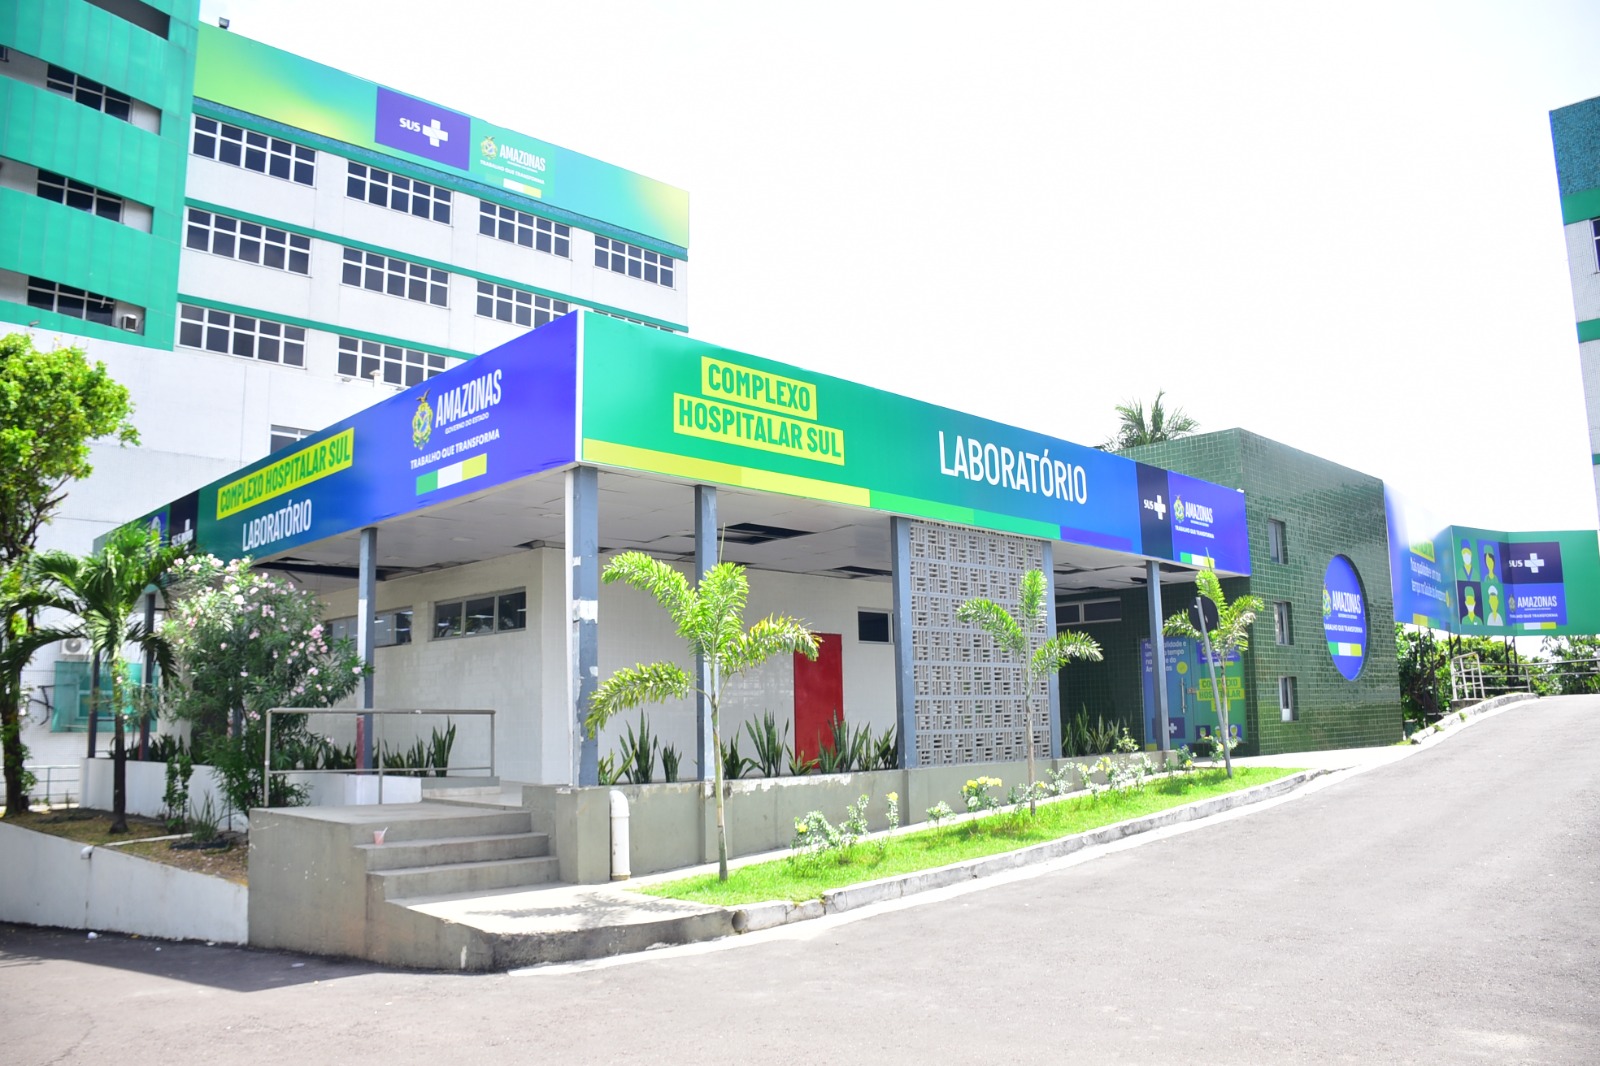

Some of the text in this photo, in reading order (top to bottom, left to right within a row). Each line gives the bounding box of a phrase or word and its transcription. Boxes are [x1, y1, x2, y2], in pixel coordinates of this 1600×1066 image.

[399, 117, 421, 132] SUS
[499, 144, 546, 172] AMAZONAS
[435, 369, 502, 428] AMAZONAS
[708, 363, 811, 412] COMPLEXO
[444, 421, 465, 435] GOVERNO
[472, 412, 490, 425] ESTADO
[679, 398, 842, 458] HOSPITALAR SUL
[410, 428, 500, 470] TRABALHO QUE TRANSFORMA
[220, 435, 351, 513] COMPLEXO HOSPITALAR SUL
[938, 430, 1088, 505] LABORATÓRIO
[1143, 499, 1154, 510] SUS
[1185, 501, 1214, 524] AMAZONAS
[242, 498, 312, 552] LABORATÓRIO
[1508, 559, 1523, 568] SUS
[1332, 590, 1361, 614] AMAZONAS
[1517, 596, 1558, 608] AMAZONAS
